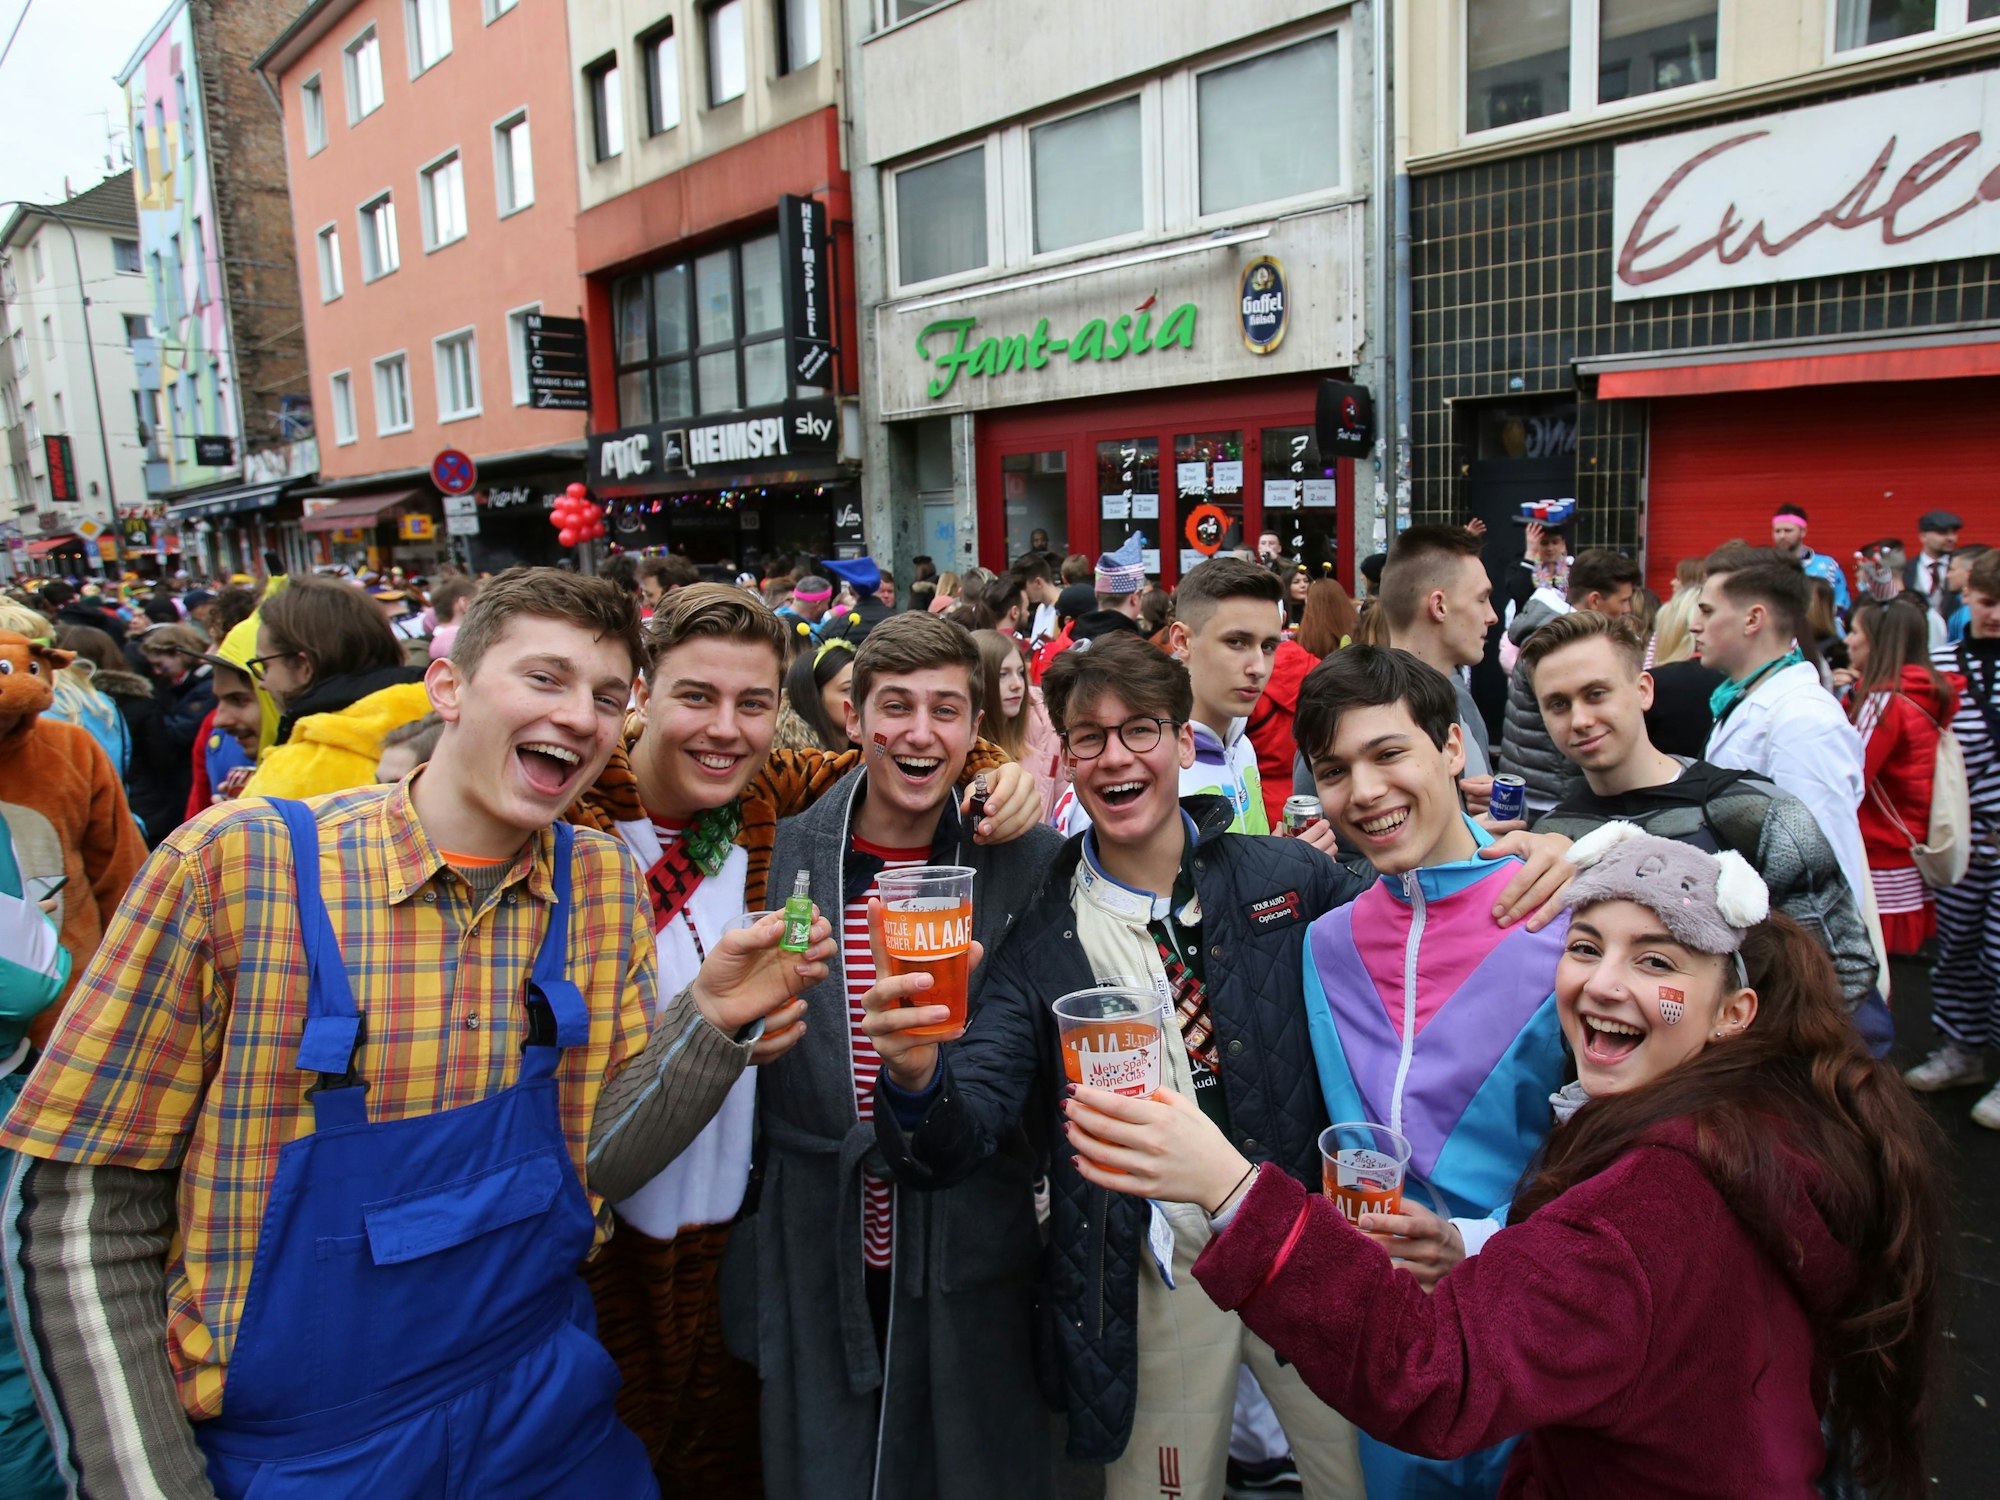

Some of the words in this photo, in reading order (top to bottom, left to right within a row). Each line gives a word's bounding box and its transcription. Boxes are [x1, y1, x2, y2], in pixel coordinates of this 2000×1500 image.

[801, 203, 816, 337] HEIMSPIEL
[1242, 291, 1284, 315] Gaffel
[795, 411, 833, 442] sky
[689, 415, 790, 466] HEIMSPI
[1252, 901, 1270, 912] TOUR
[1269, 895, 1286, 906] AUTO
[1093, 1062, 1120, 1076] Mehr
[1123, 1055, 1148, 1072] Spaß
[1096, 1074, 1123, 1087] ohne
[1125, 1068, 1146, 1082] Glas
